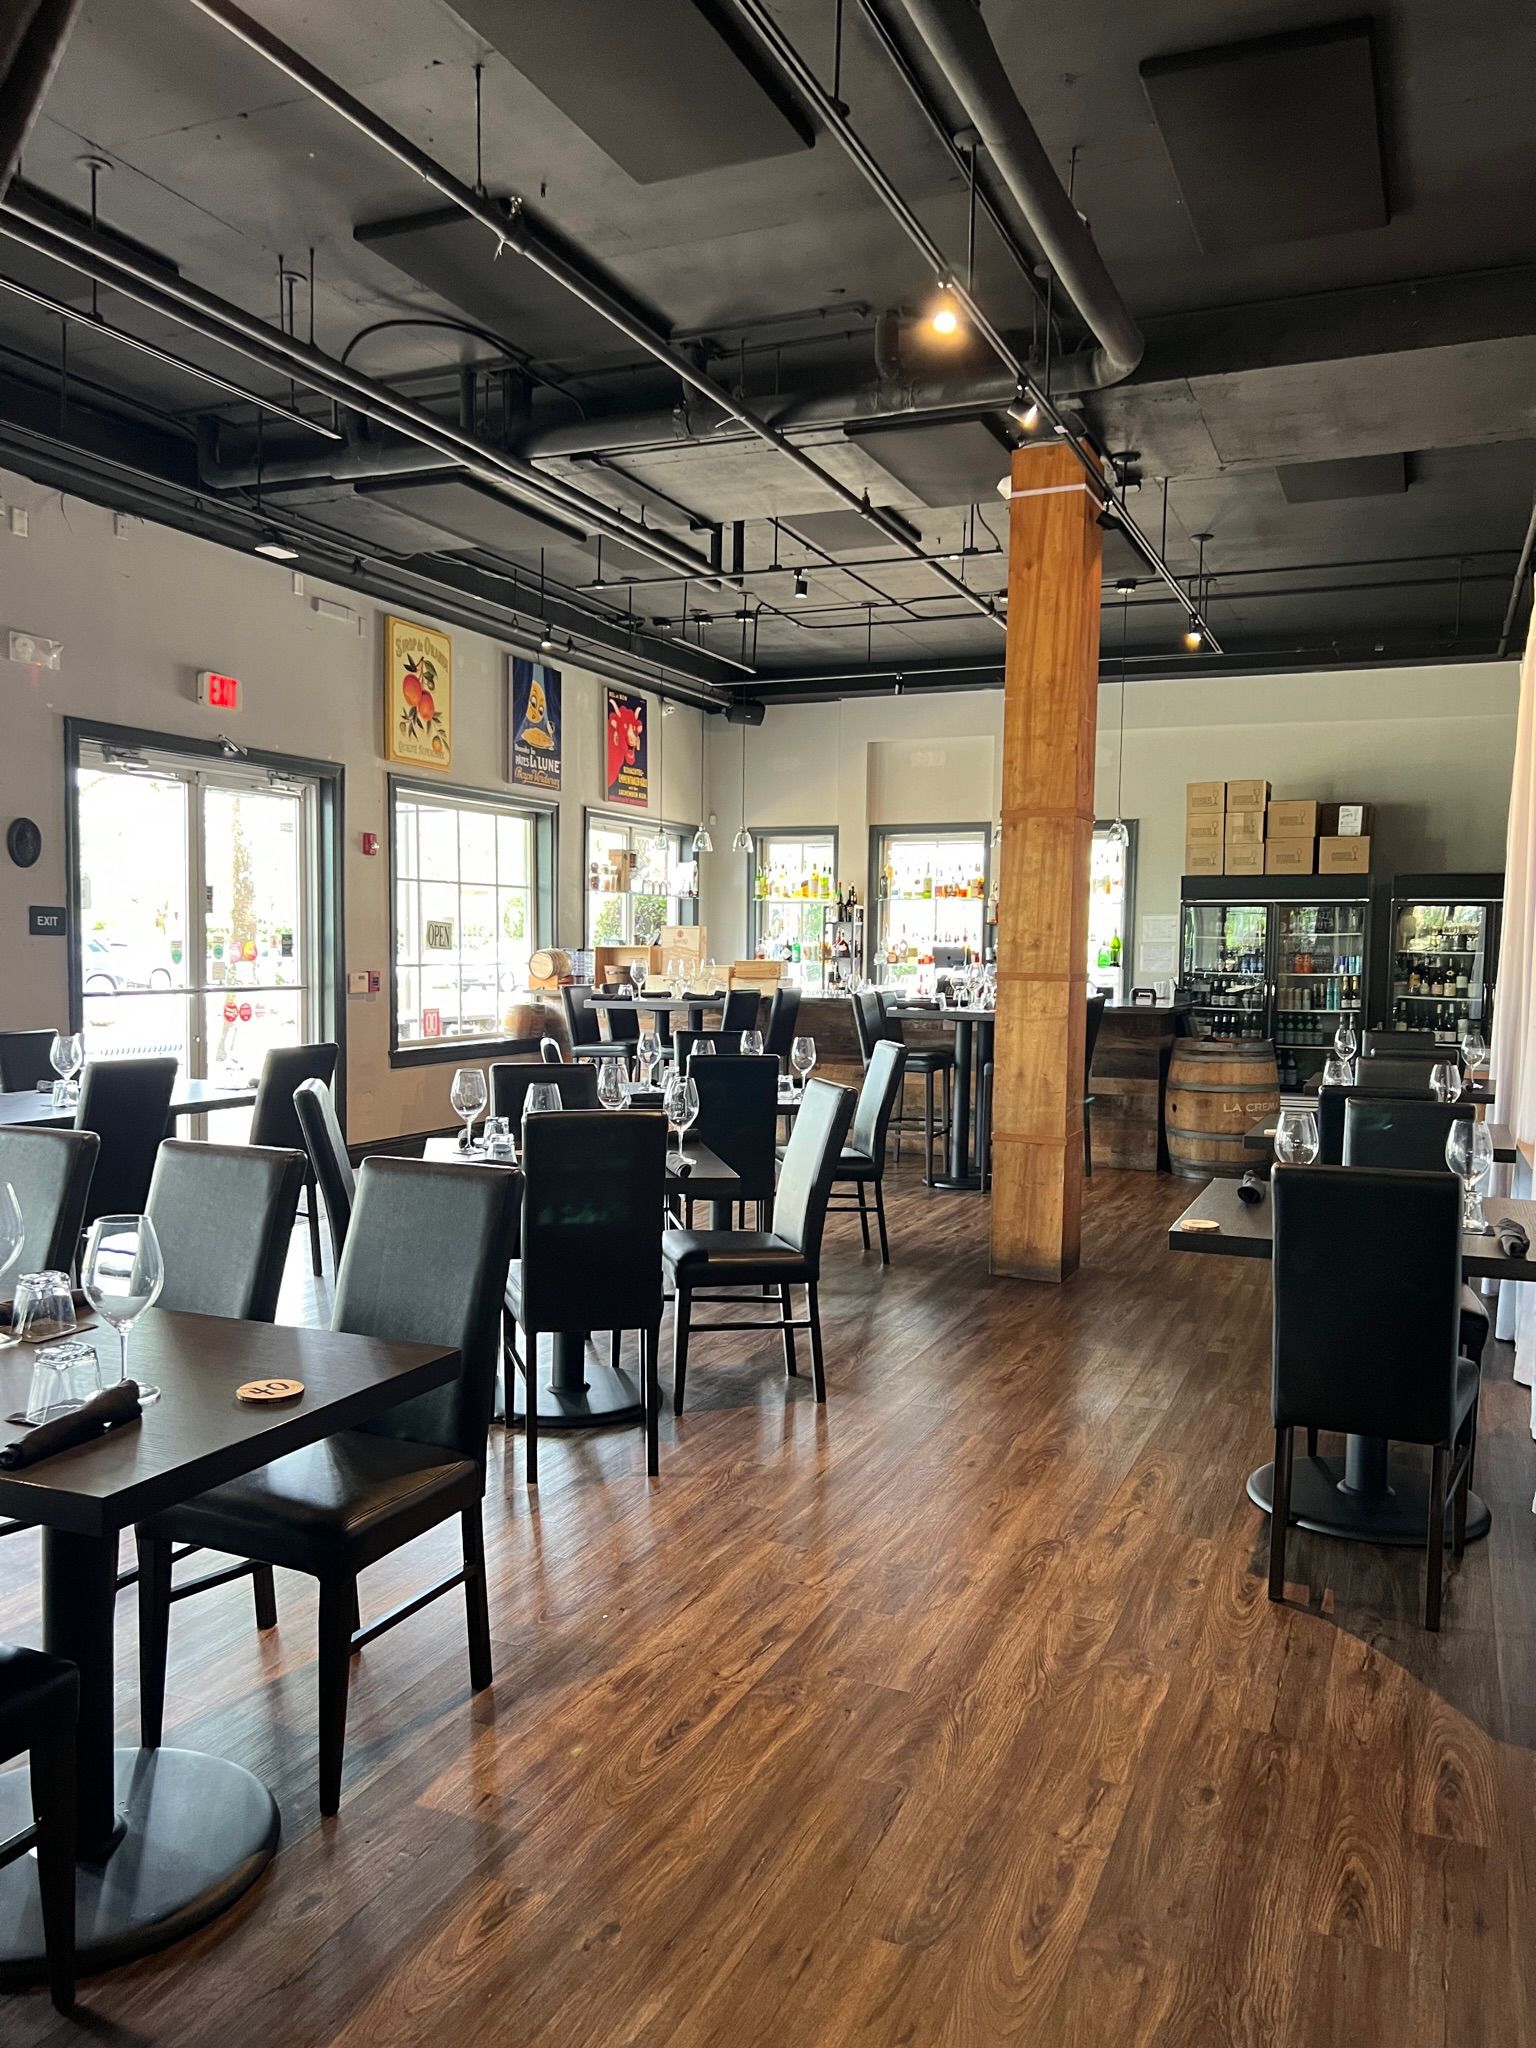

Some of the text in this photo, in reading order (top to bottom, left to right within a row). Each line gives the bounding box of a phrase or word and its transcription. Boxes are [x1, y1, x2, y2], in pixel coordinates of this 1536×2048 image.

[210, 674, 239, 708] EXIT
[536, 756, 561, 774] LUNE
[37, 916, 58, 926] EXIT
[428, 924, 451, 947] OPEN
[1223, 1102, 1279, 1112] LA CREM
[249, 1382, 290, 1396] 40
